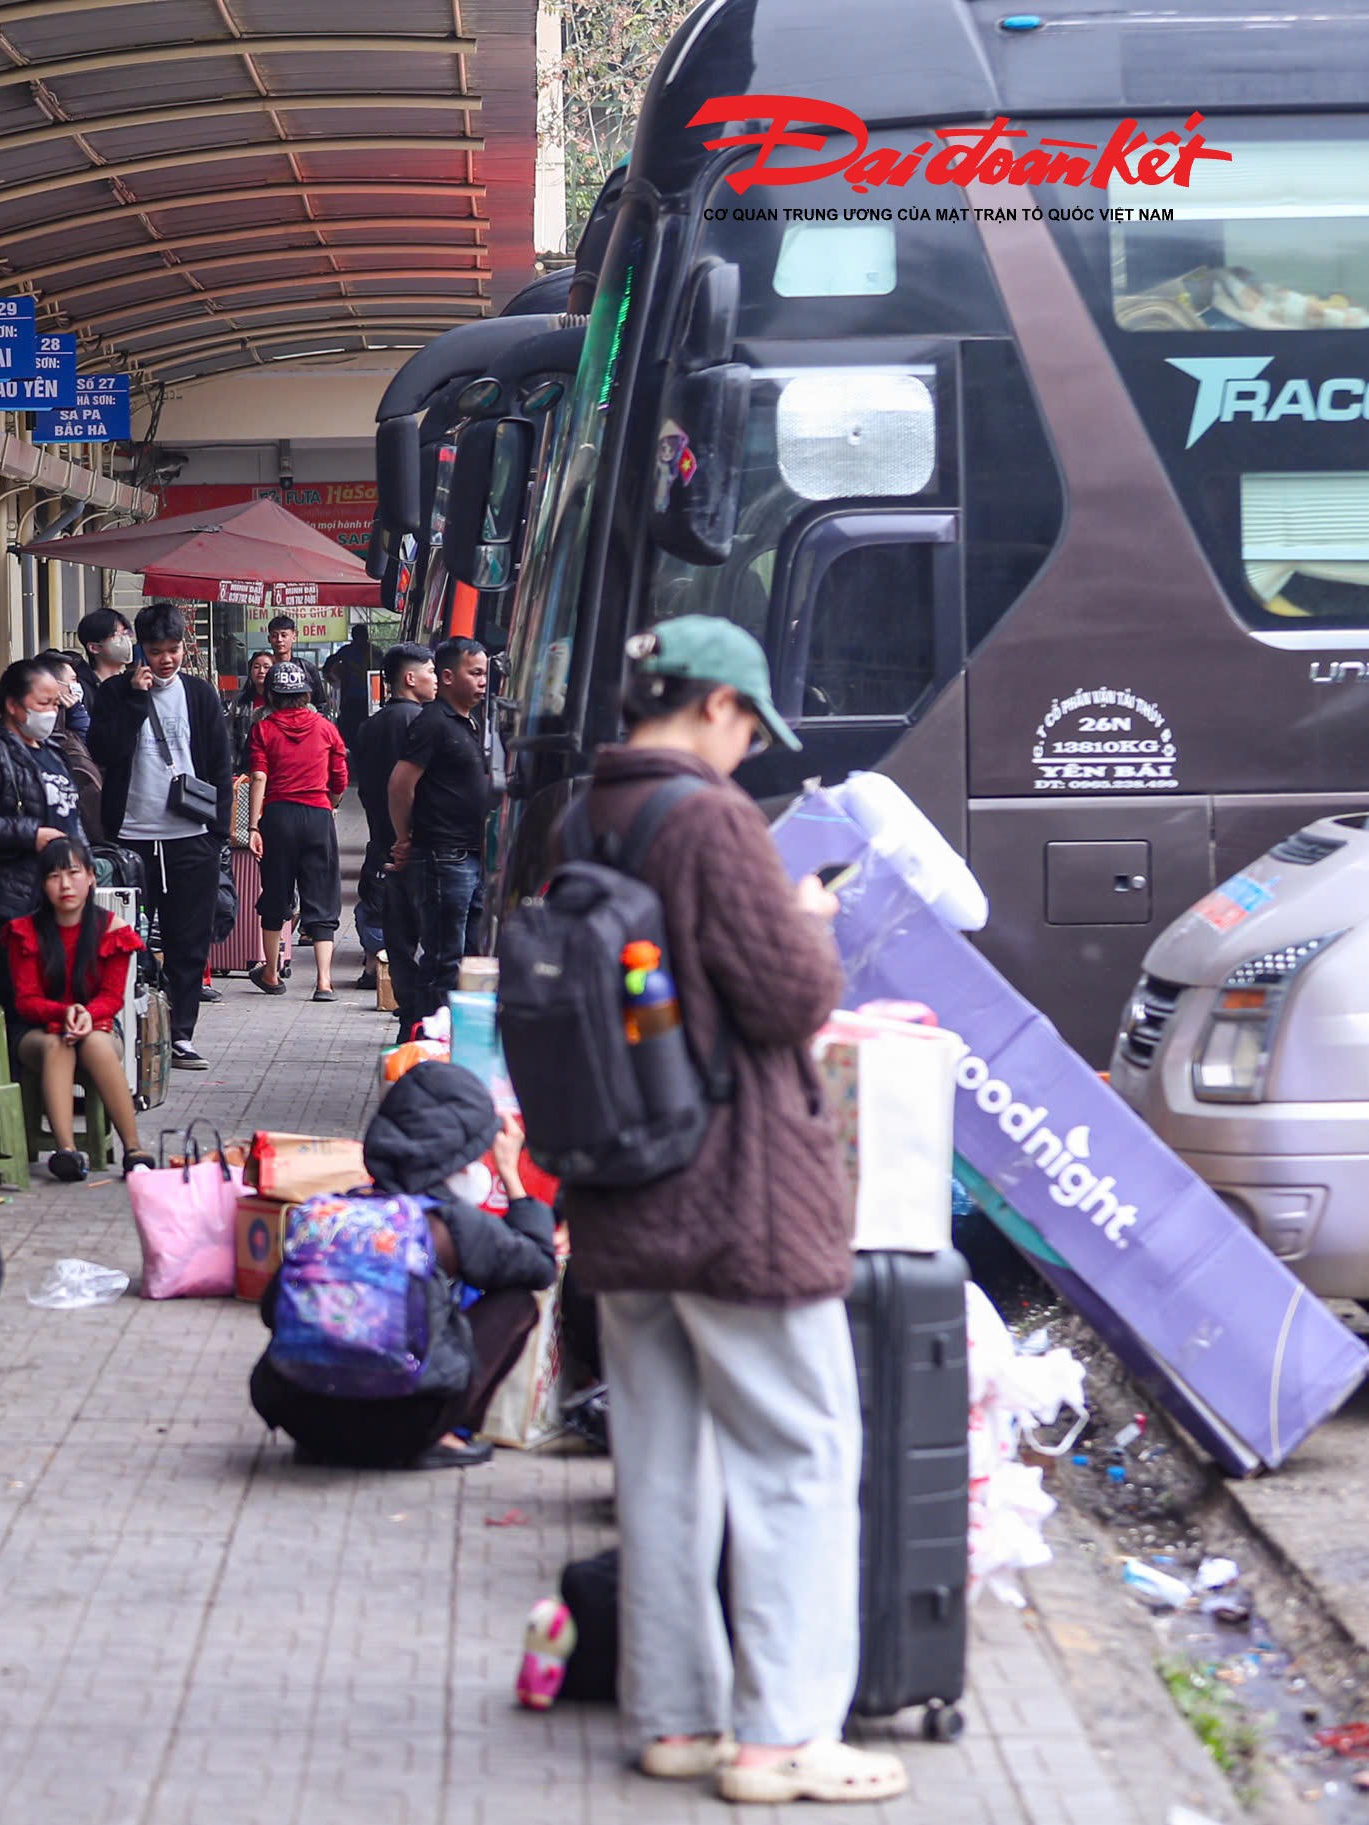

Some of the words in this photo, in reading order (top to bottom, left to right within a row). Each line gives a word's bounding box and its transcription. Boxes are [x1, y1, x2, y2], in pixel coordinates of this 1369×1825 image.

[41, 338, 61, 351] 28
[99, 378, 116, 390] 27
[1164, 356, 1369, 450] TRAC
[83, 409, 101, 420] PA
[87, 423, 107, 436] HÀ
[285, 489, 322, 506] FUTA
[1078, 717, 1132, 732] 26N
[1038, 763, 1108, 778] YÊN
[956, 1055, 1139, 1242] oodnight
